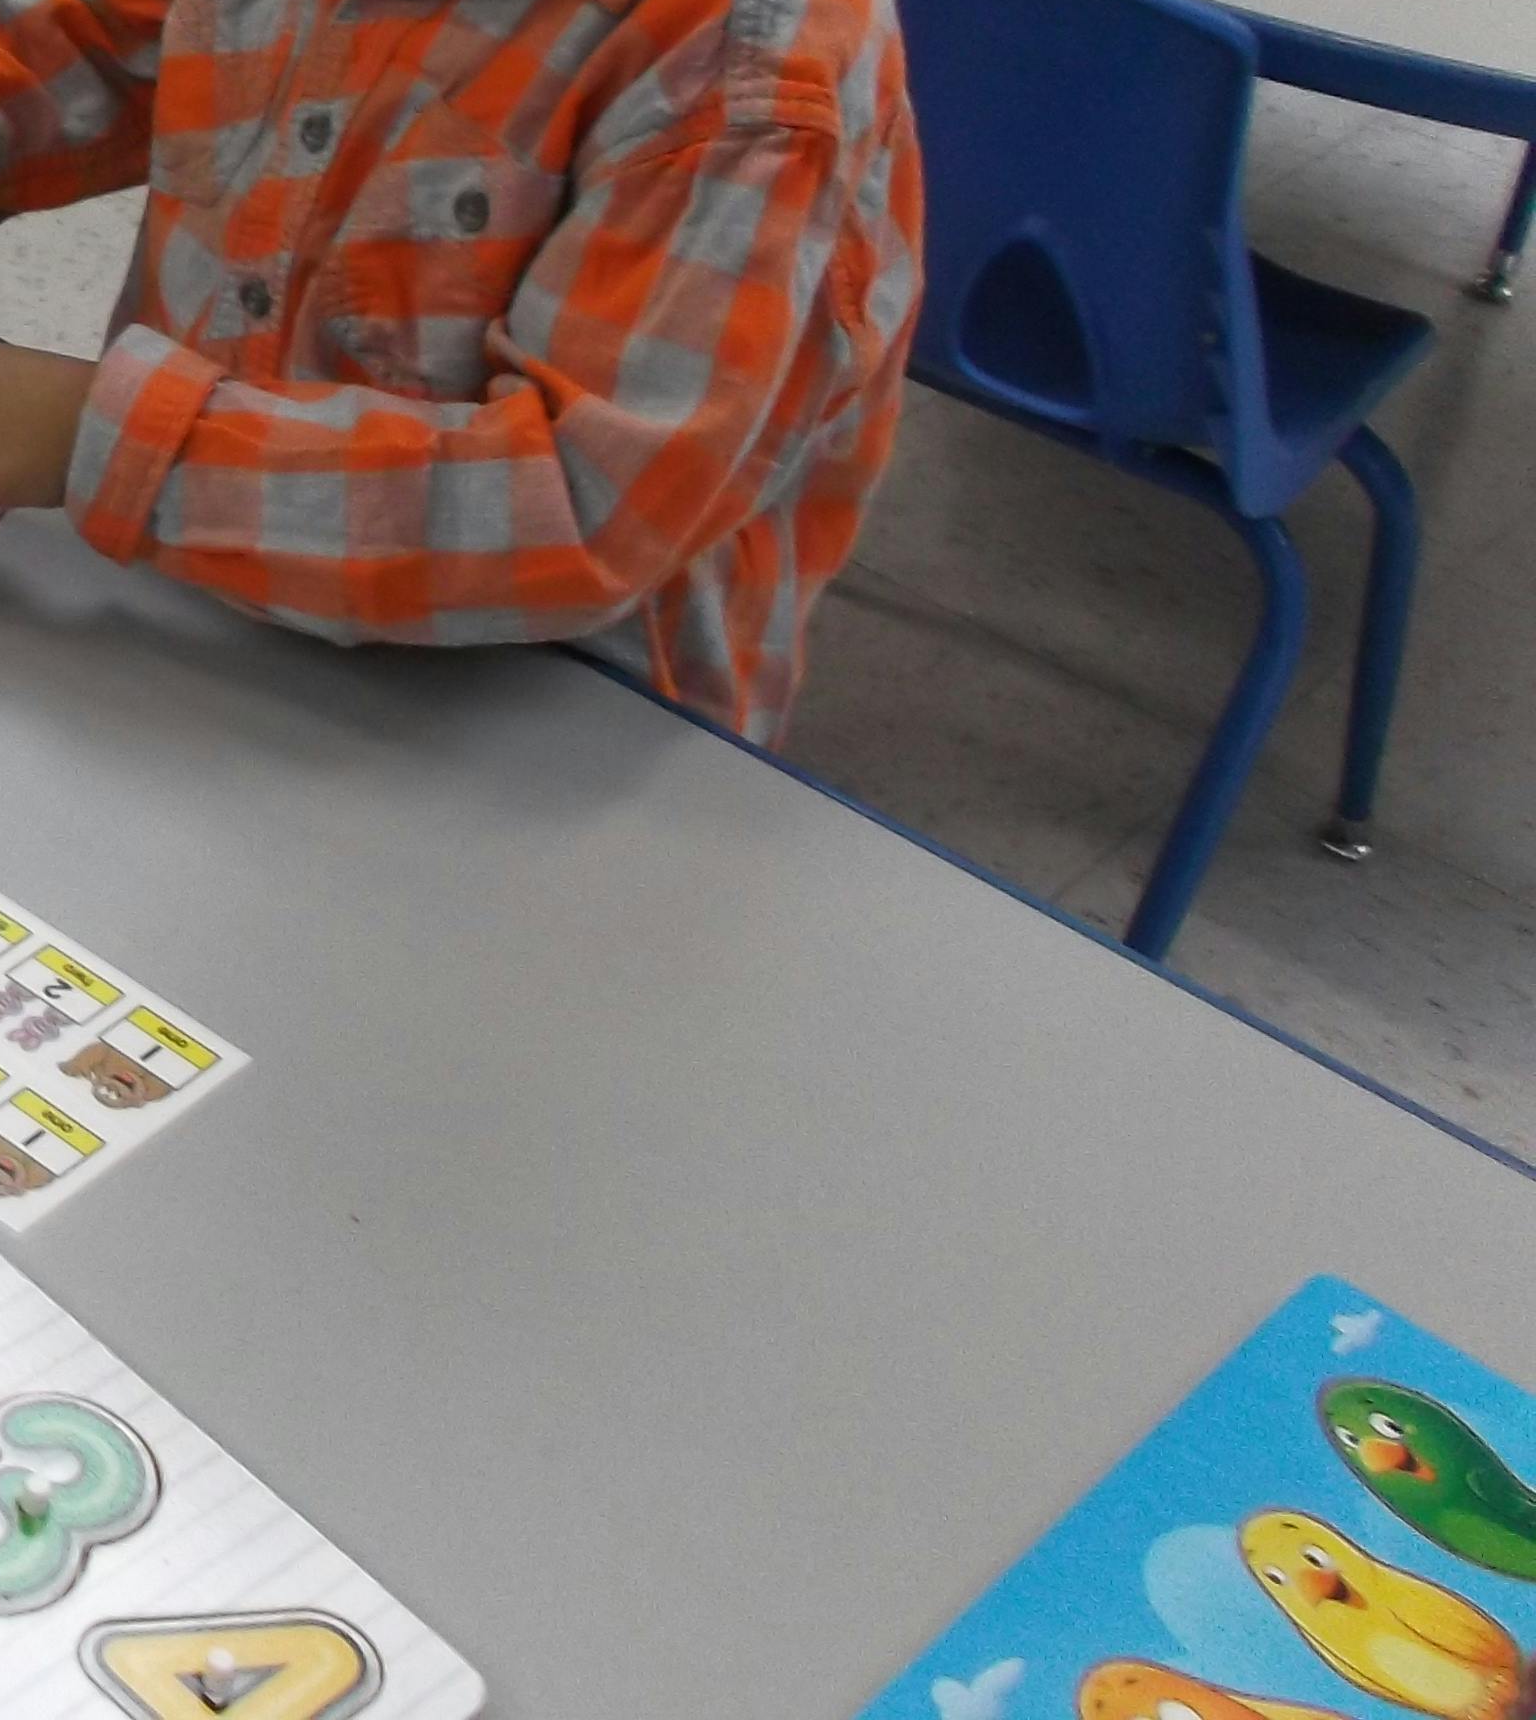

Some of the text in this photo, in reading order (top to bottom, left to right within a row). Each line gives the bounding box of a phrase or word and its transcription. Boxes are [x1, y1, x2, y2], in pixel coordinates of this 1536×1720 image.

[43, 978, 72, 999] 2
[140, 1045, 162, 1062] 1
[22, 1129, 46, 1146] 1
